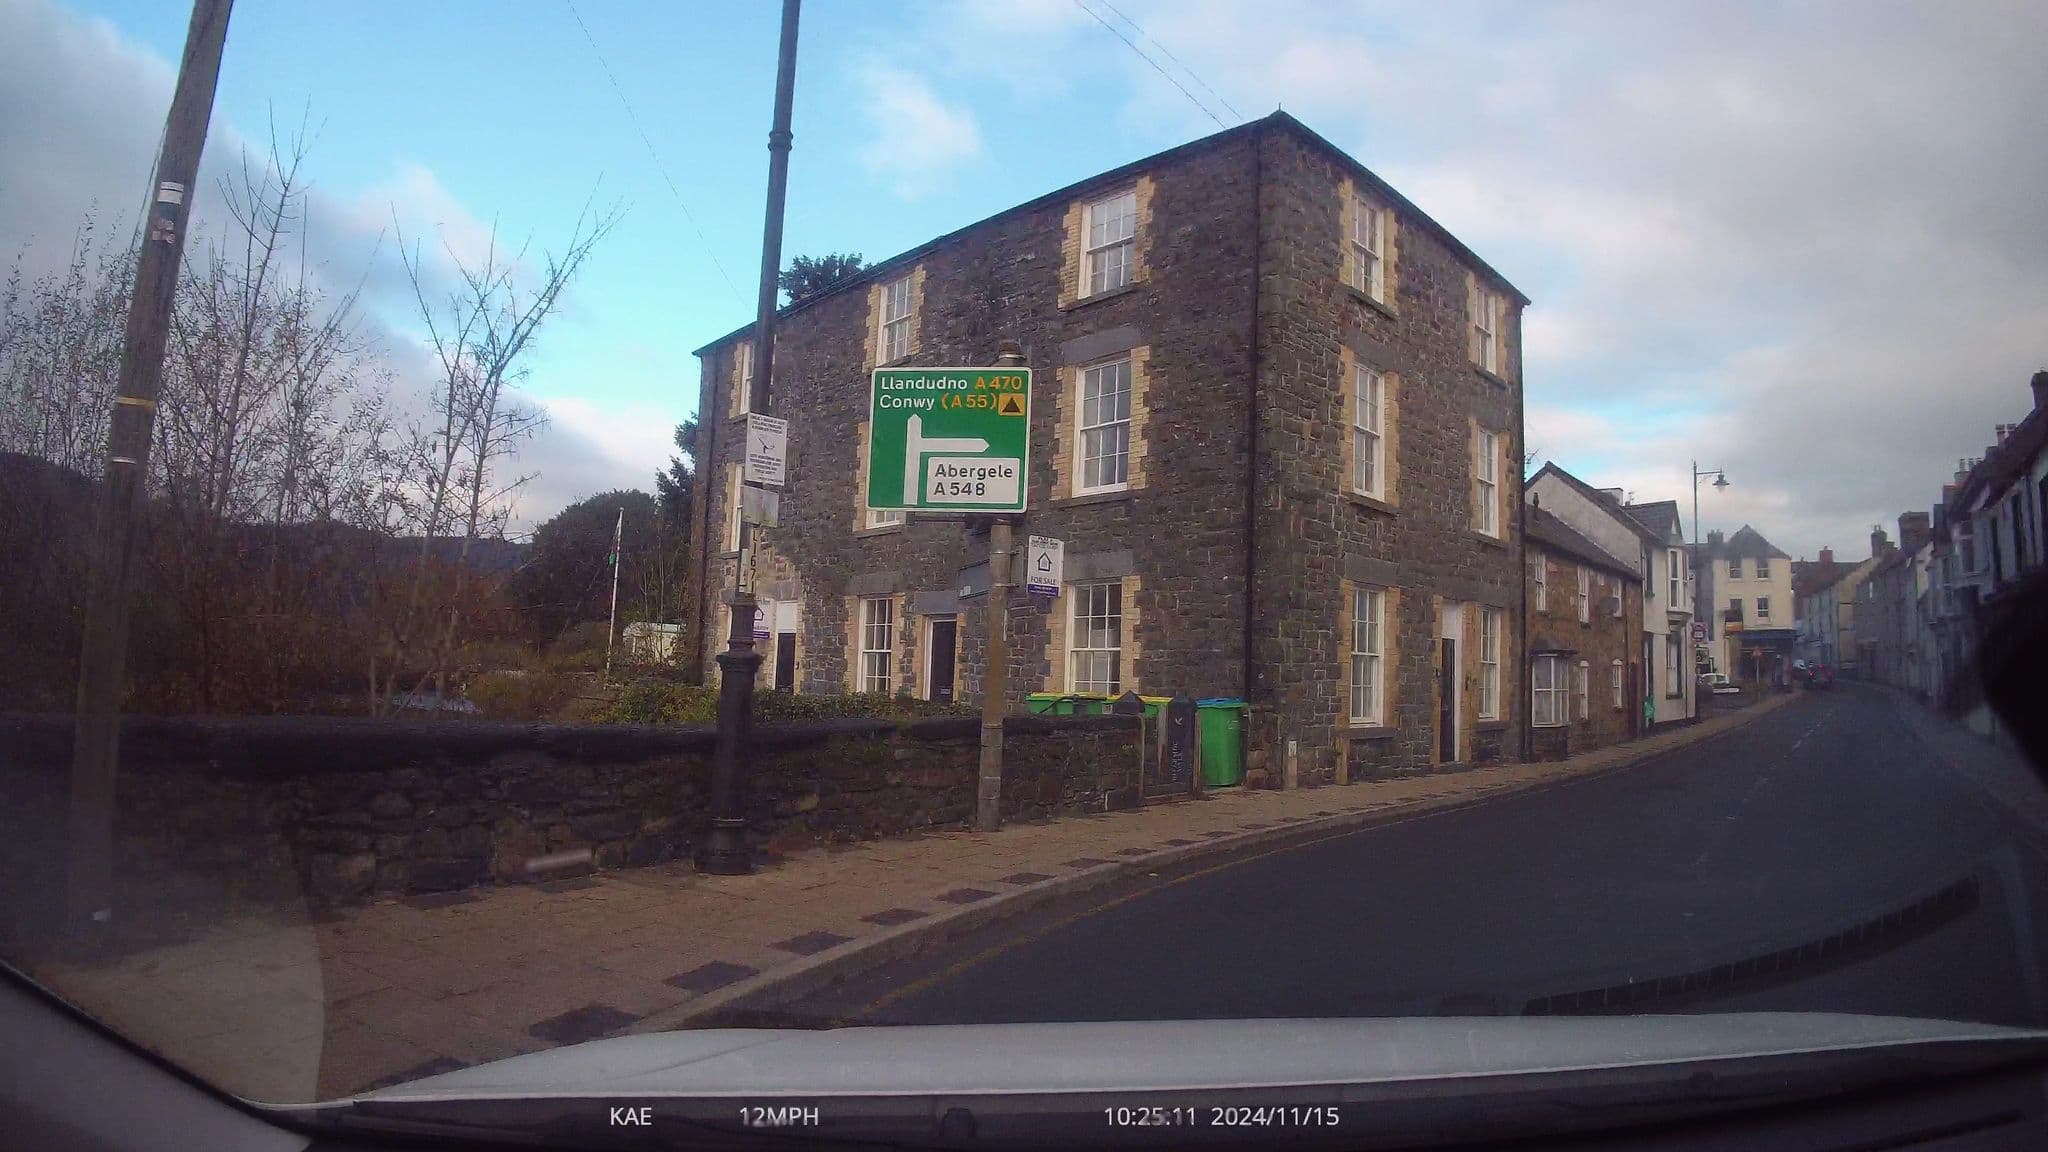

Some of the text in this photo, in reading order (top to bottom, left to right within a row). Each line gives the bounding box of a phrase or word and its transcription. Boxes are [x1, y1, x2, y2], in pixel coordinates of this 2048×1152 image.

[881, 376, 968, 390] Llandudno
[880, 395, 935, 411] Conwy
[935, 464, 1013, 480] Abergele
